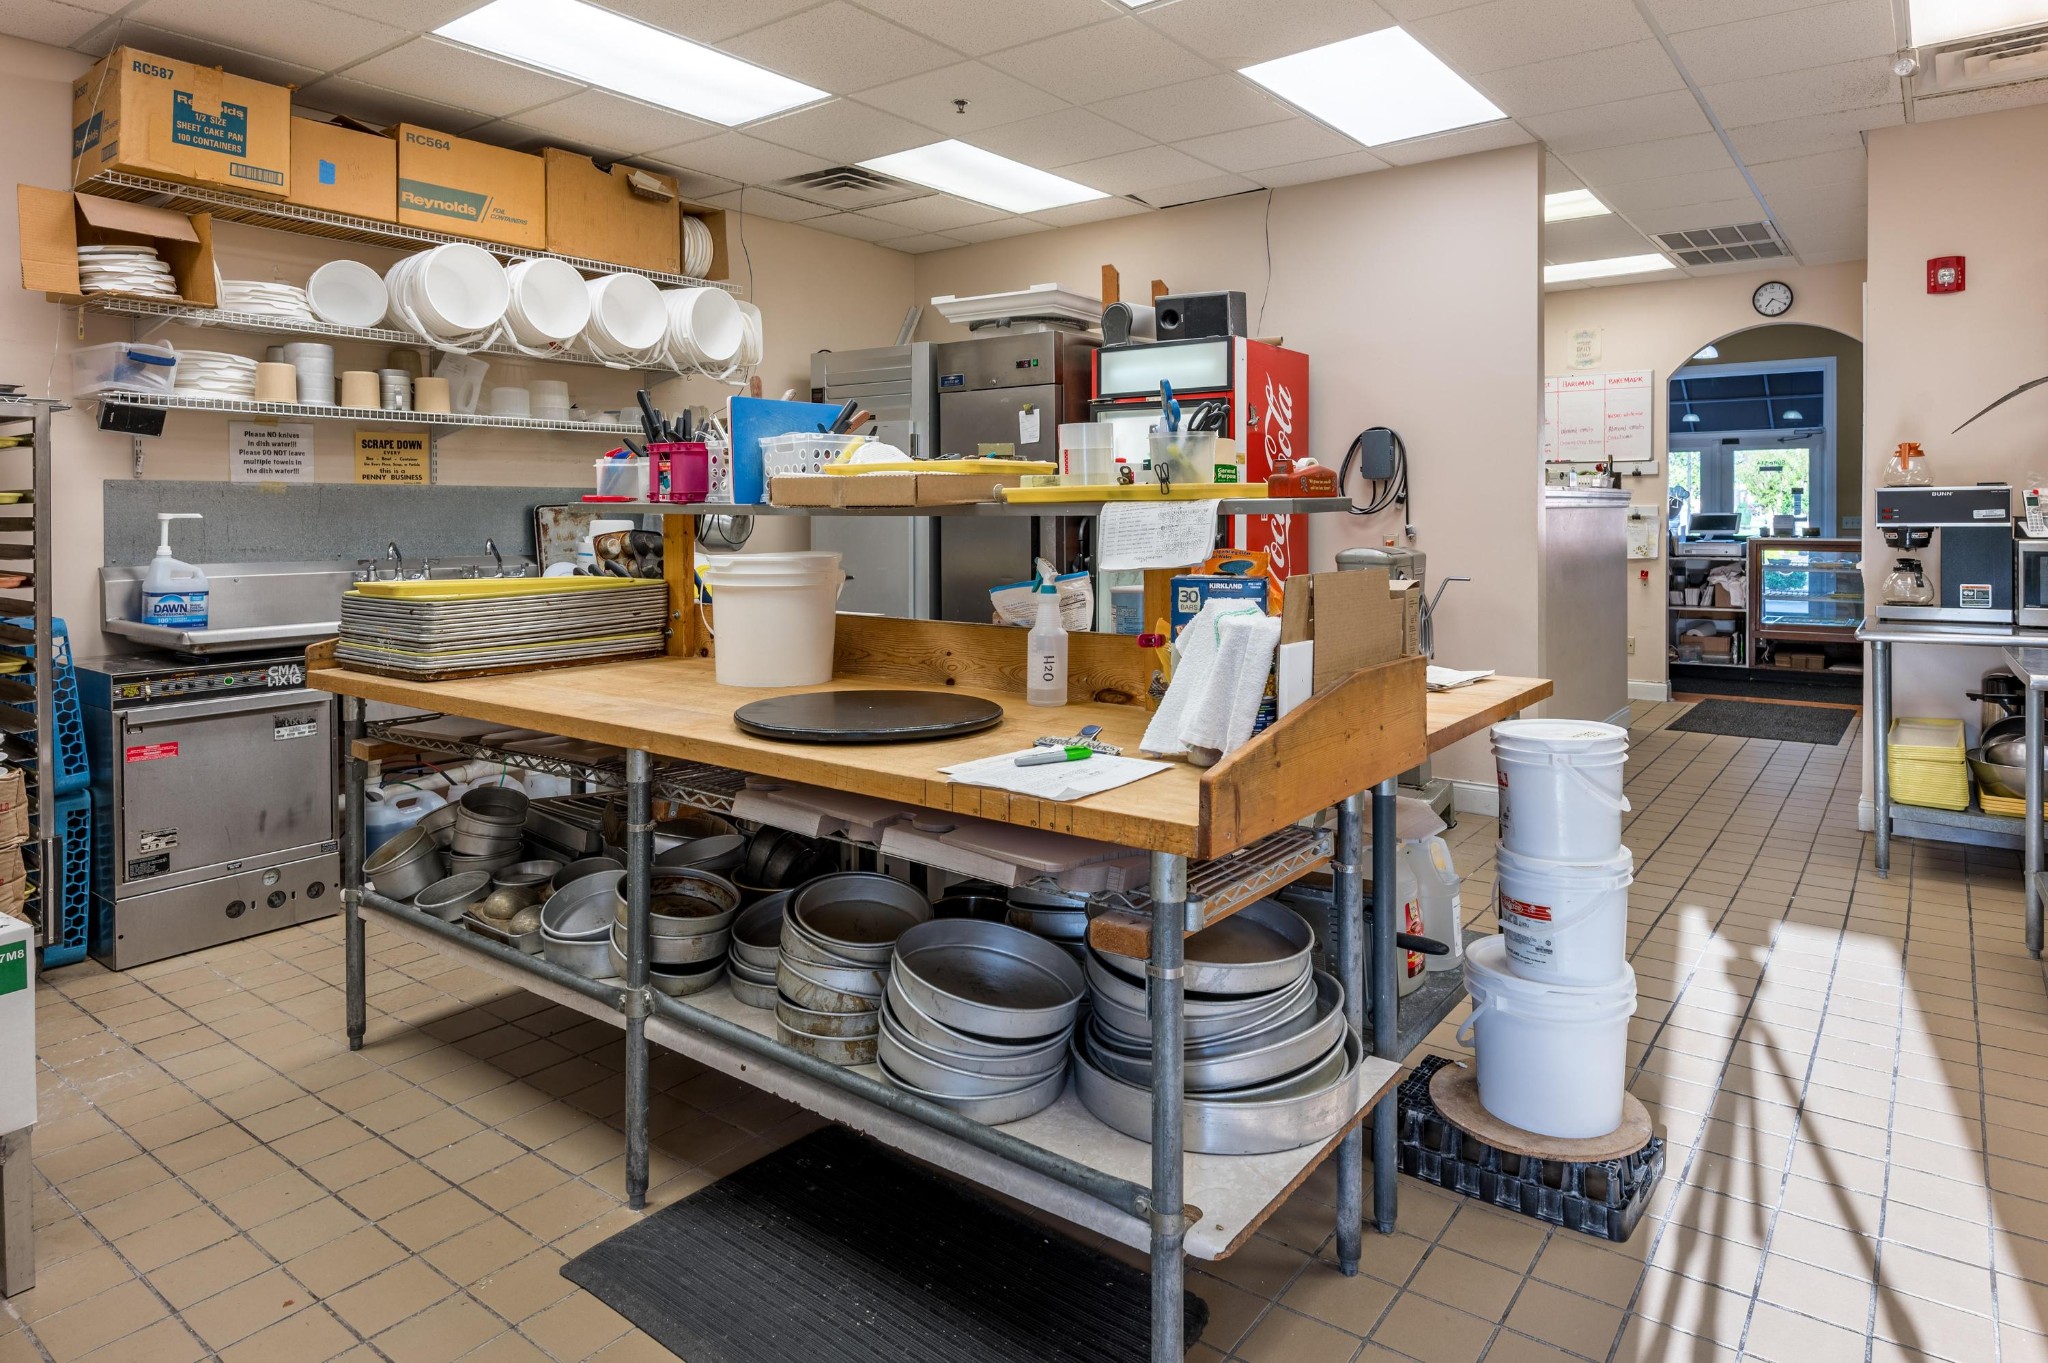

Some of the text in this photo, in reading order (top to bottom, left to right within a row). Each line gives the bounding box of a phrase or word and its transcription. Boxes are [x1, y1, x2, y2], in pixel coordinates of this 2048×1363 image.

[132, 60, 174, 80] RC587
[176, 93, 244, 120] Relds
[194, 112, 227, 127] 1/2 SIZE
[176, 120, 244, 142] SHEET CAKE PAN
[177, 132, 242, 153] 100 CONTAINERS
[405, 132, 450, 150] RC564
[401, 191, 477, 217] Reynolds
[492, 207, 506, 216] FOIL
[490, 213, 528, 226] CONTAINERS
[362, 439, 422, 450] SCRAPE DOWN
[1180, 590, 1198, 603] 30
[154, 604, 188, 613] DAWN
[268, 664, 300, 676] CMA
